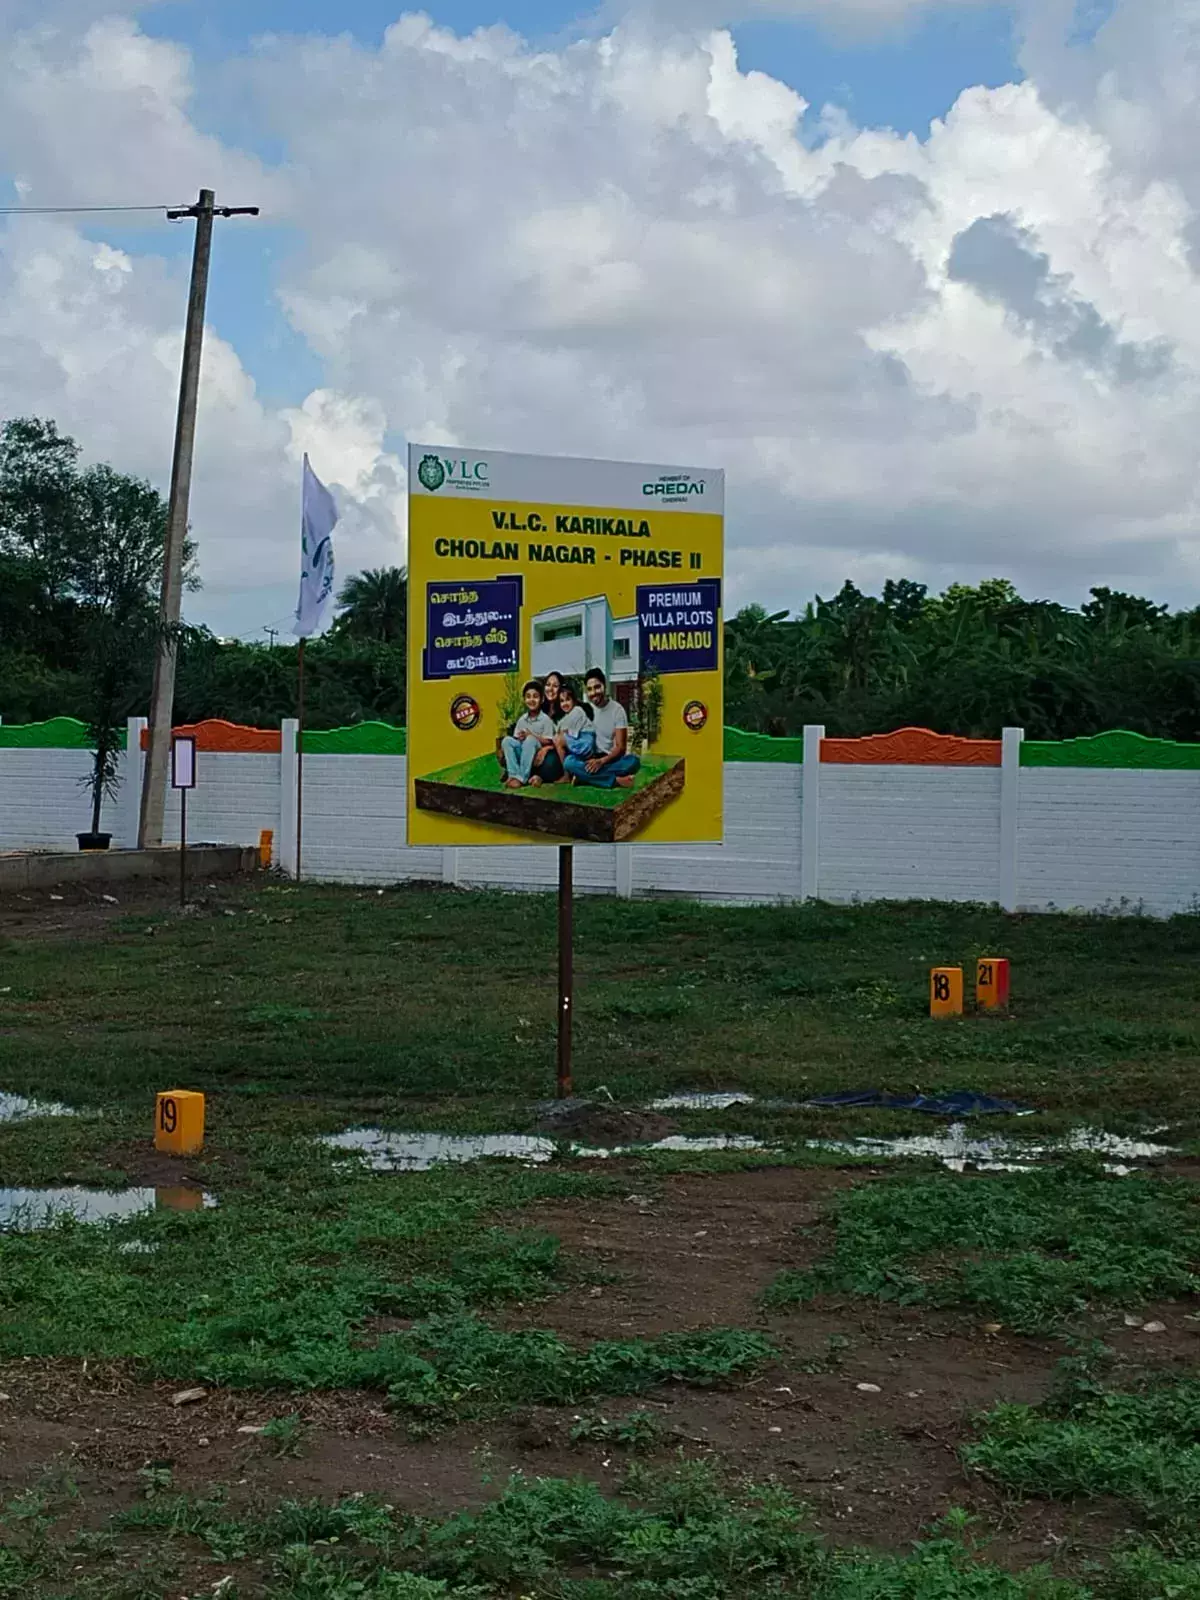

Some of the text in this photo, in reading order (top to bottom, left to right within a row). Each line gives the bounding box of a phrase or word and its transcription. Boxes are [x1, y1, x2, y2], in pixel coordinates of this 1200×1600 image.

[492, 511, 651, 538] V.L.C. KARIKALA
[434, 538, 519, 560] CHOLAN
[528, 543, 596, 565] NAGAR
[620, 548, 682, 569] PHASE
[689, 552, 702, 569] II
[430, 587, 479, 604] சொந்த
[648, 591, 702, 608] PREMIUM
[641, 611, 714, 628] VILLA PLOTS
[434, 631, 483, 649] சொந்த
[649, 631, 713, 652] MANGADU
[978, 964, 993, 985] 21
[933, 973, 950, 1001] 18
[160, 1098, 177, 1133] 19
